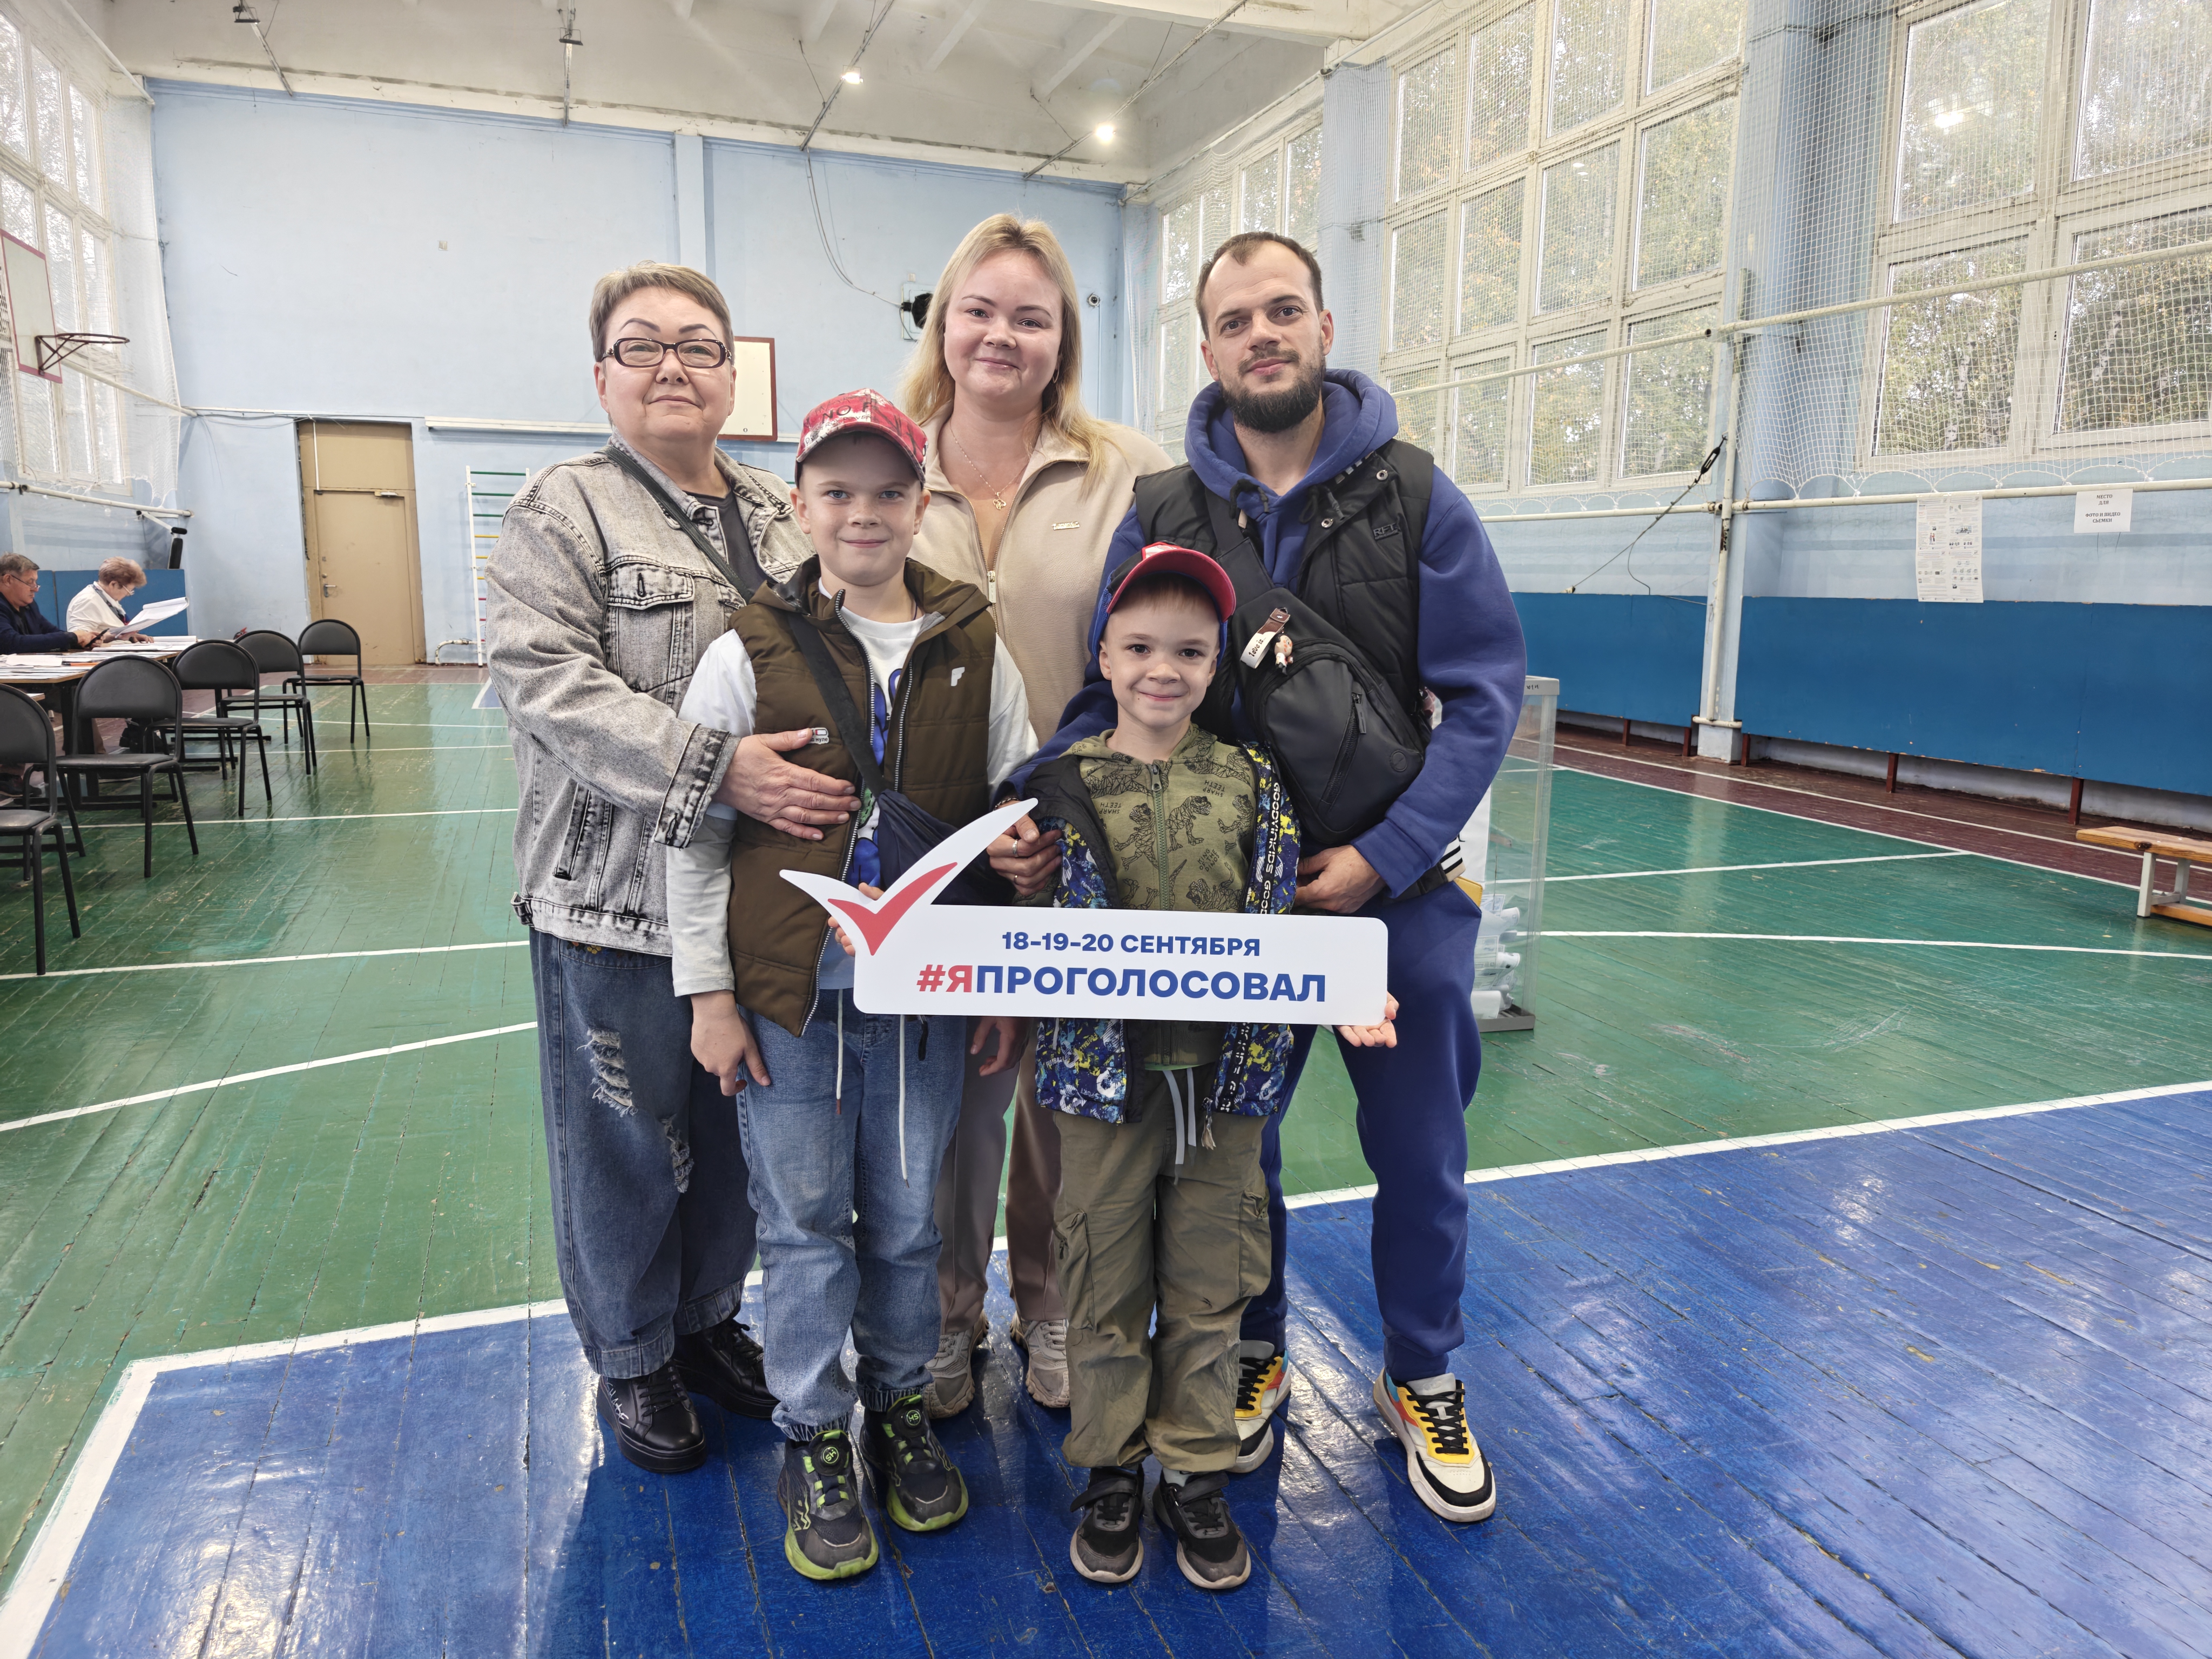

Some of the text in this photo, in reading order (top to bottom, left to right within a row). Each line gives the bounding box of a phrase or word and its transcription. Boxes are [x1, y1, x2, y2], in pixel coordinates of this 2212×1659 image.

[1203, 786, 1224, 798] SHARP
[1204, 780, 1225, 792] TEETH
[1197, 848, 1210, 865] KING
[1199, 849, 1217, 871] OF THE
[1205, 854, 1220, 872] DINOS
[1002, 932, 1260, 956] 18-19-20 СЕНТЯБРЯ
[916, 964, 1325, 1002] #ЯПРОГОЛОСОВАЛ
